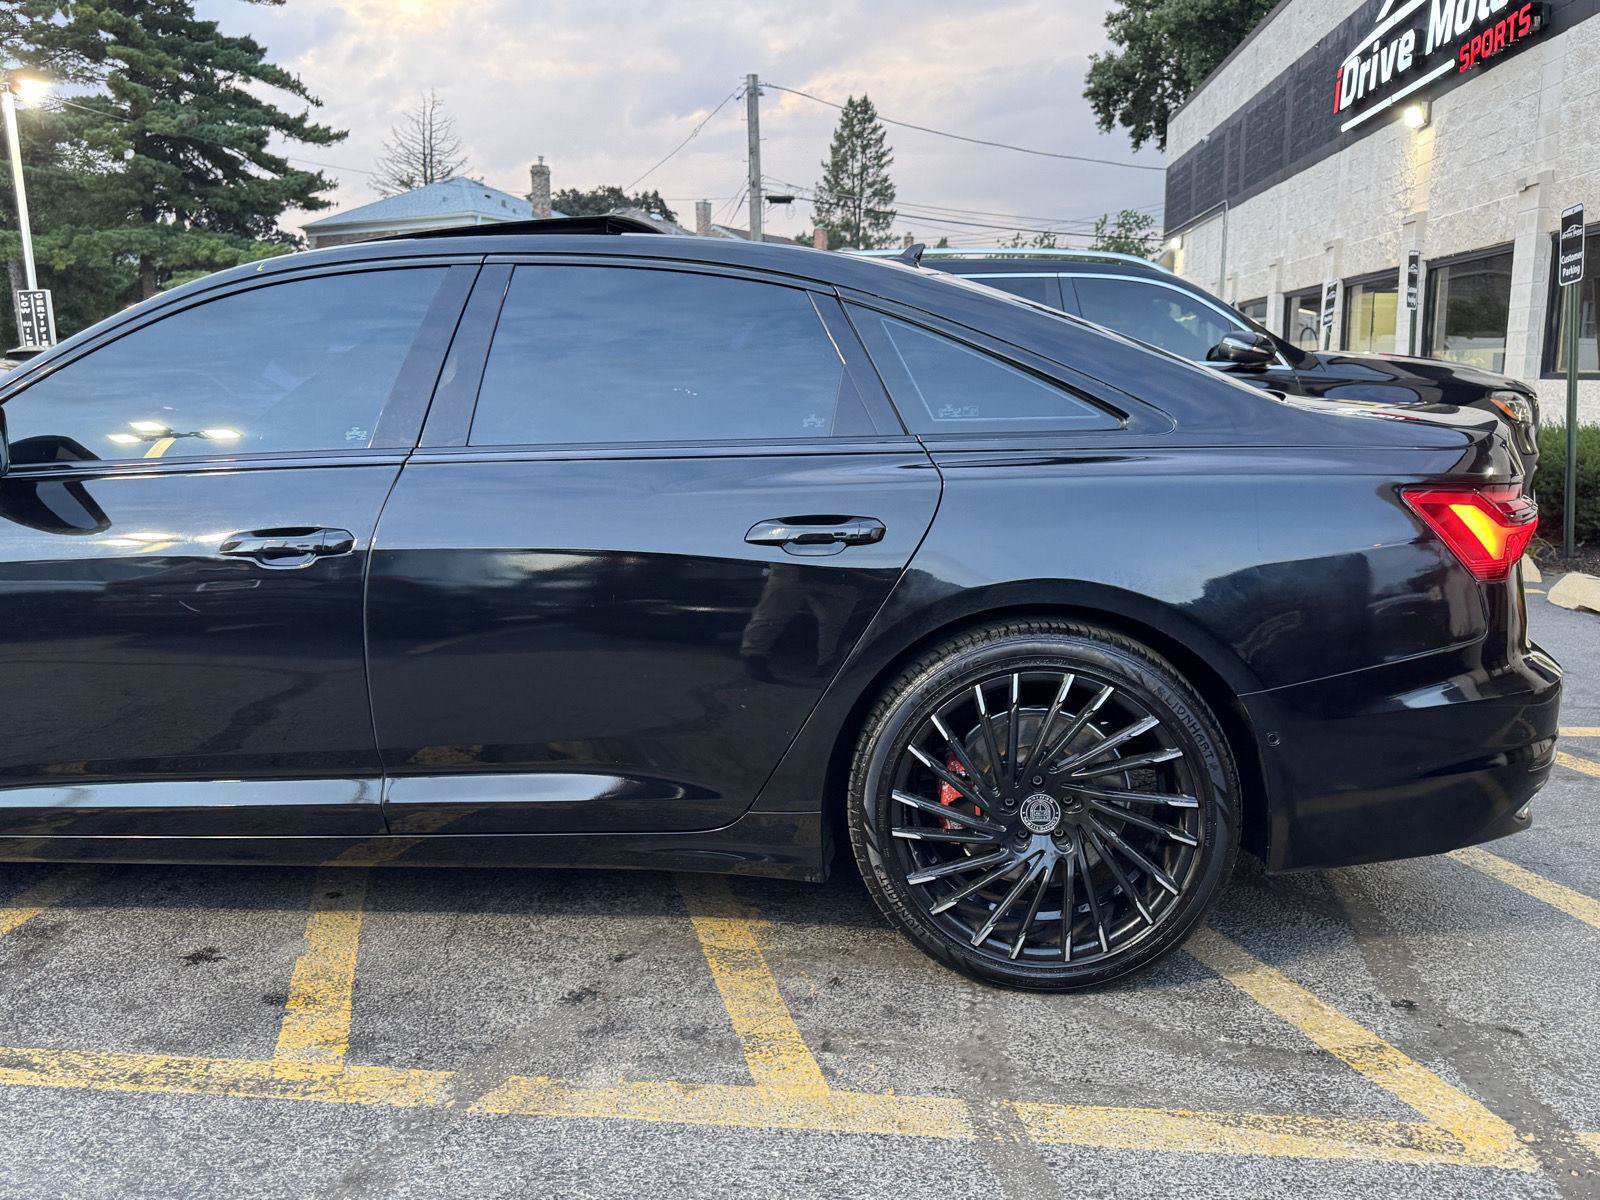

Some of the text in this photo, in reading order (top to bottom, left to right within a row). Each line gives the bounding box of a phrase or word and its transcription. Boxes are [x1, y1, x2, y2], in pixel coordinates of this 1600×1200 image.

[1333, 0, 1509, 114] iDrive Mo
[1459, 2, 1531, 72] SPORTS
[1561, 251, 1584, 265] Customer
[1562, 265, 1581, 277] Parking
[20, 294, 31, 314] LOW
[1164, 693, 1215, 759] LIONHART
